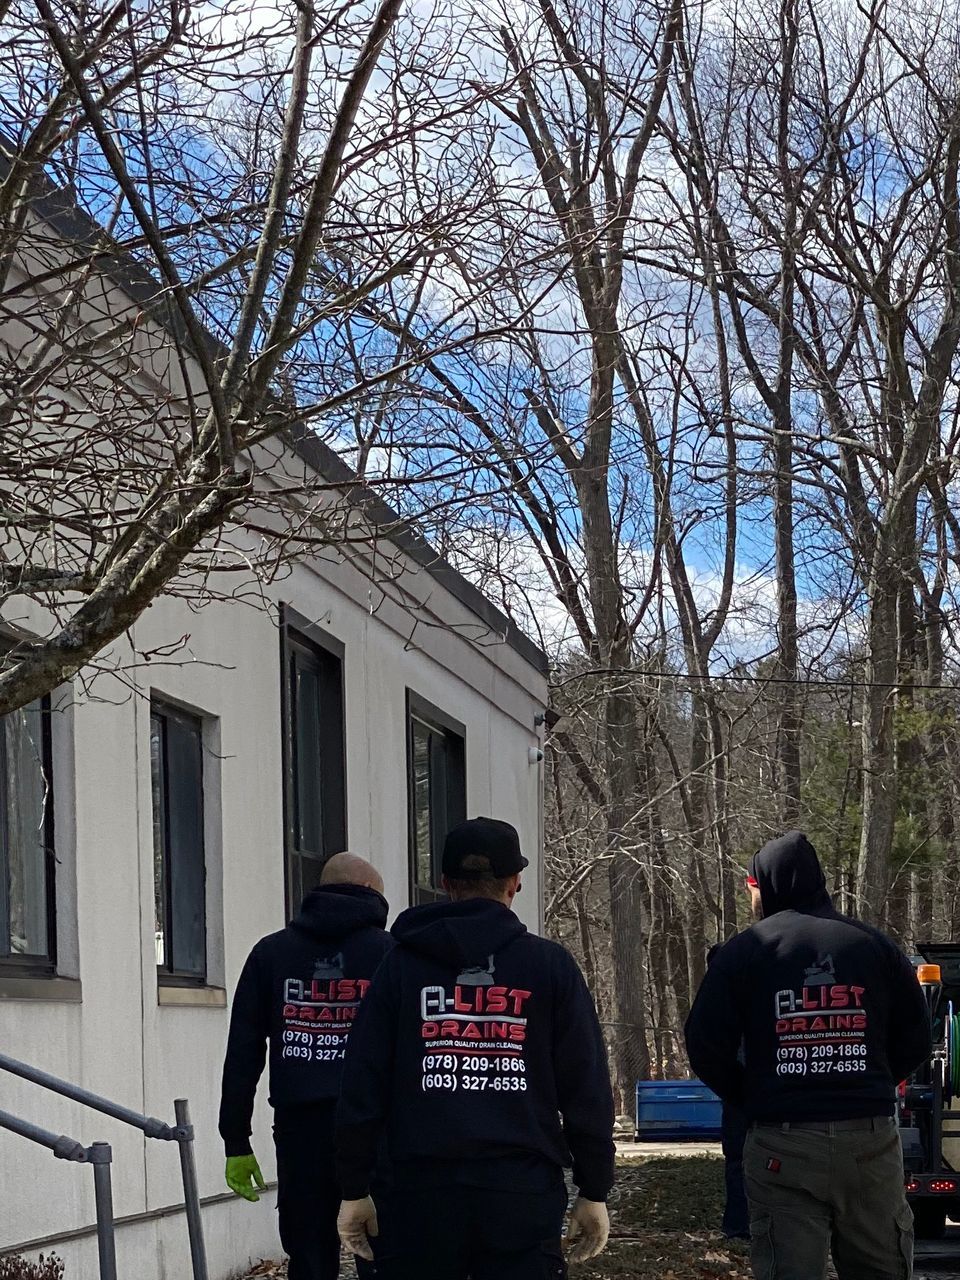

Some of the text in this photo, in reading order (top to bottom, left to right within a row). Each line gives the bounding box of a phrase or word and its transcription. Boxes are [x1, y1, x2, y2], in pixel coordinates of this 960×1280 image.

[421, 985, 532, 1016] A-LIST
[775, 985, 865, 1015] A-LIST
[282, 1004, 358, 1021] DRAIN
[421, 1021, 527, 1041] DRAINS
[775, 1015, 867, 1033] DRAINS
[282, 1030, 314, 1047] (978)
[780, 1033, 804, 1041] SUPERIOR
[803, 1032, 825, 1040] QUALITY
[282, 1045, 313, 1062] (603)
[425, 1040, 453, 1048] SUPERIOR
[496, 1042, 523, 1051] CLEANING
[776, 1044, 867, 1062] (978) 209-1866
[422, 1055, 526, 1072] (978) 209-1866
[776, 1060, 867, 1076] (603) 327-6535
[421, 1074, 528, 1092] (603) 327-6535
